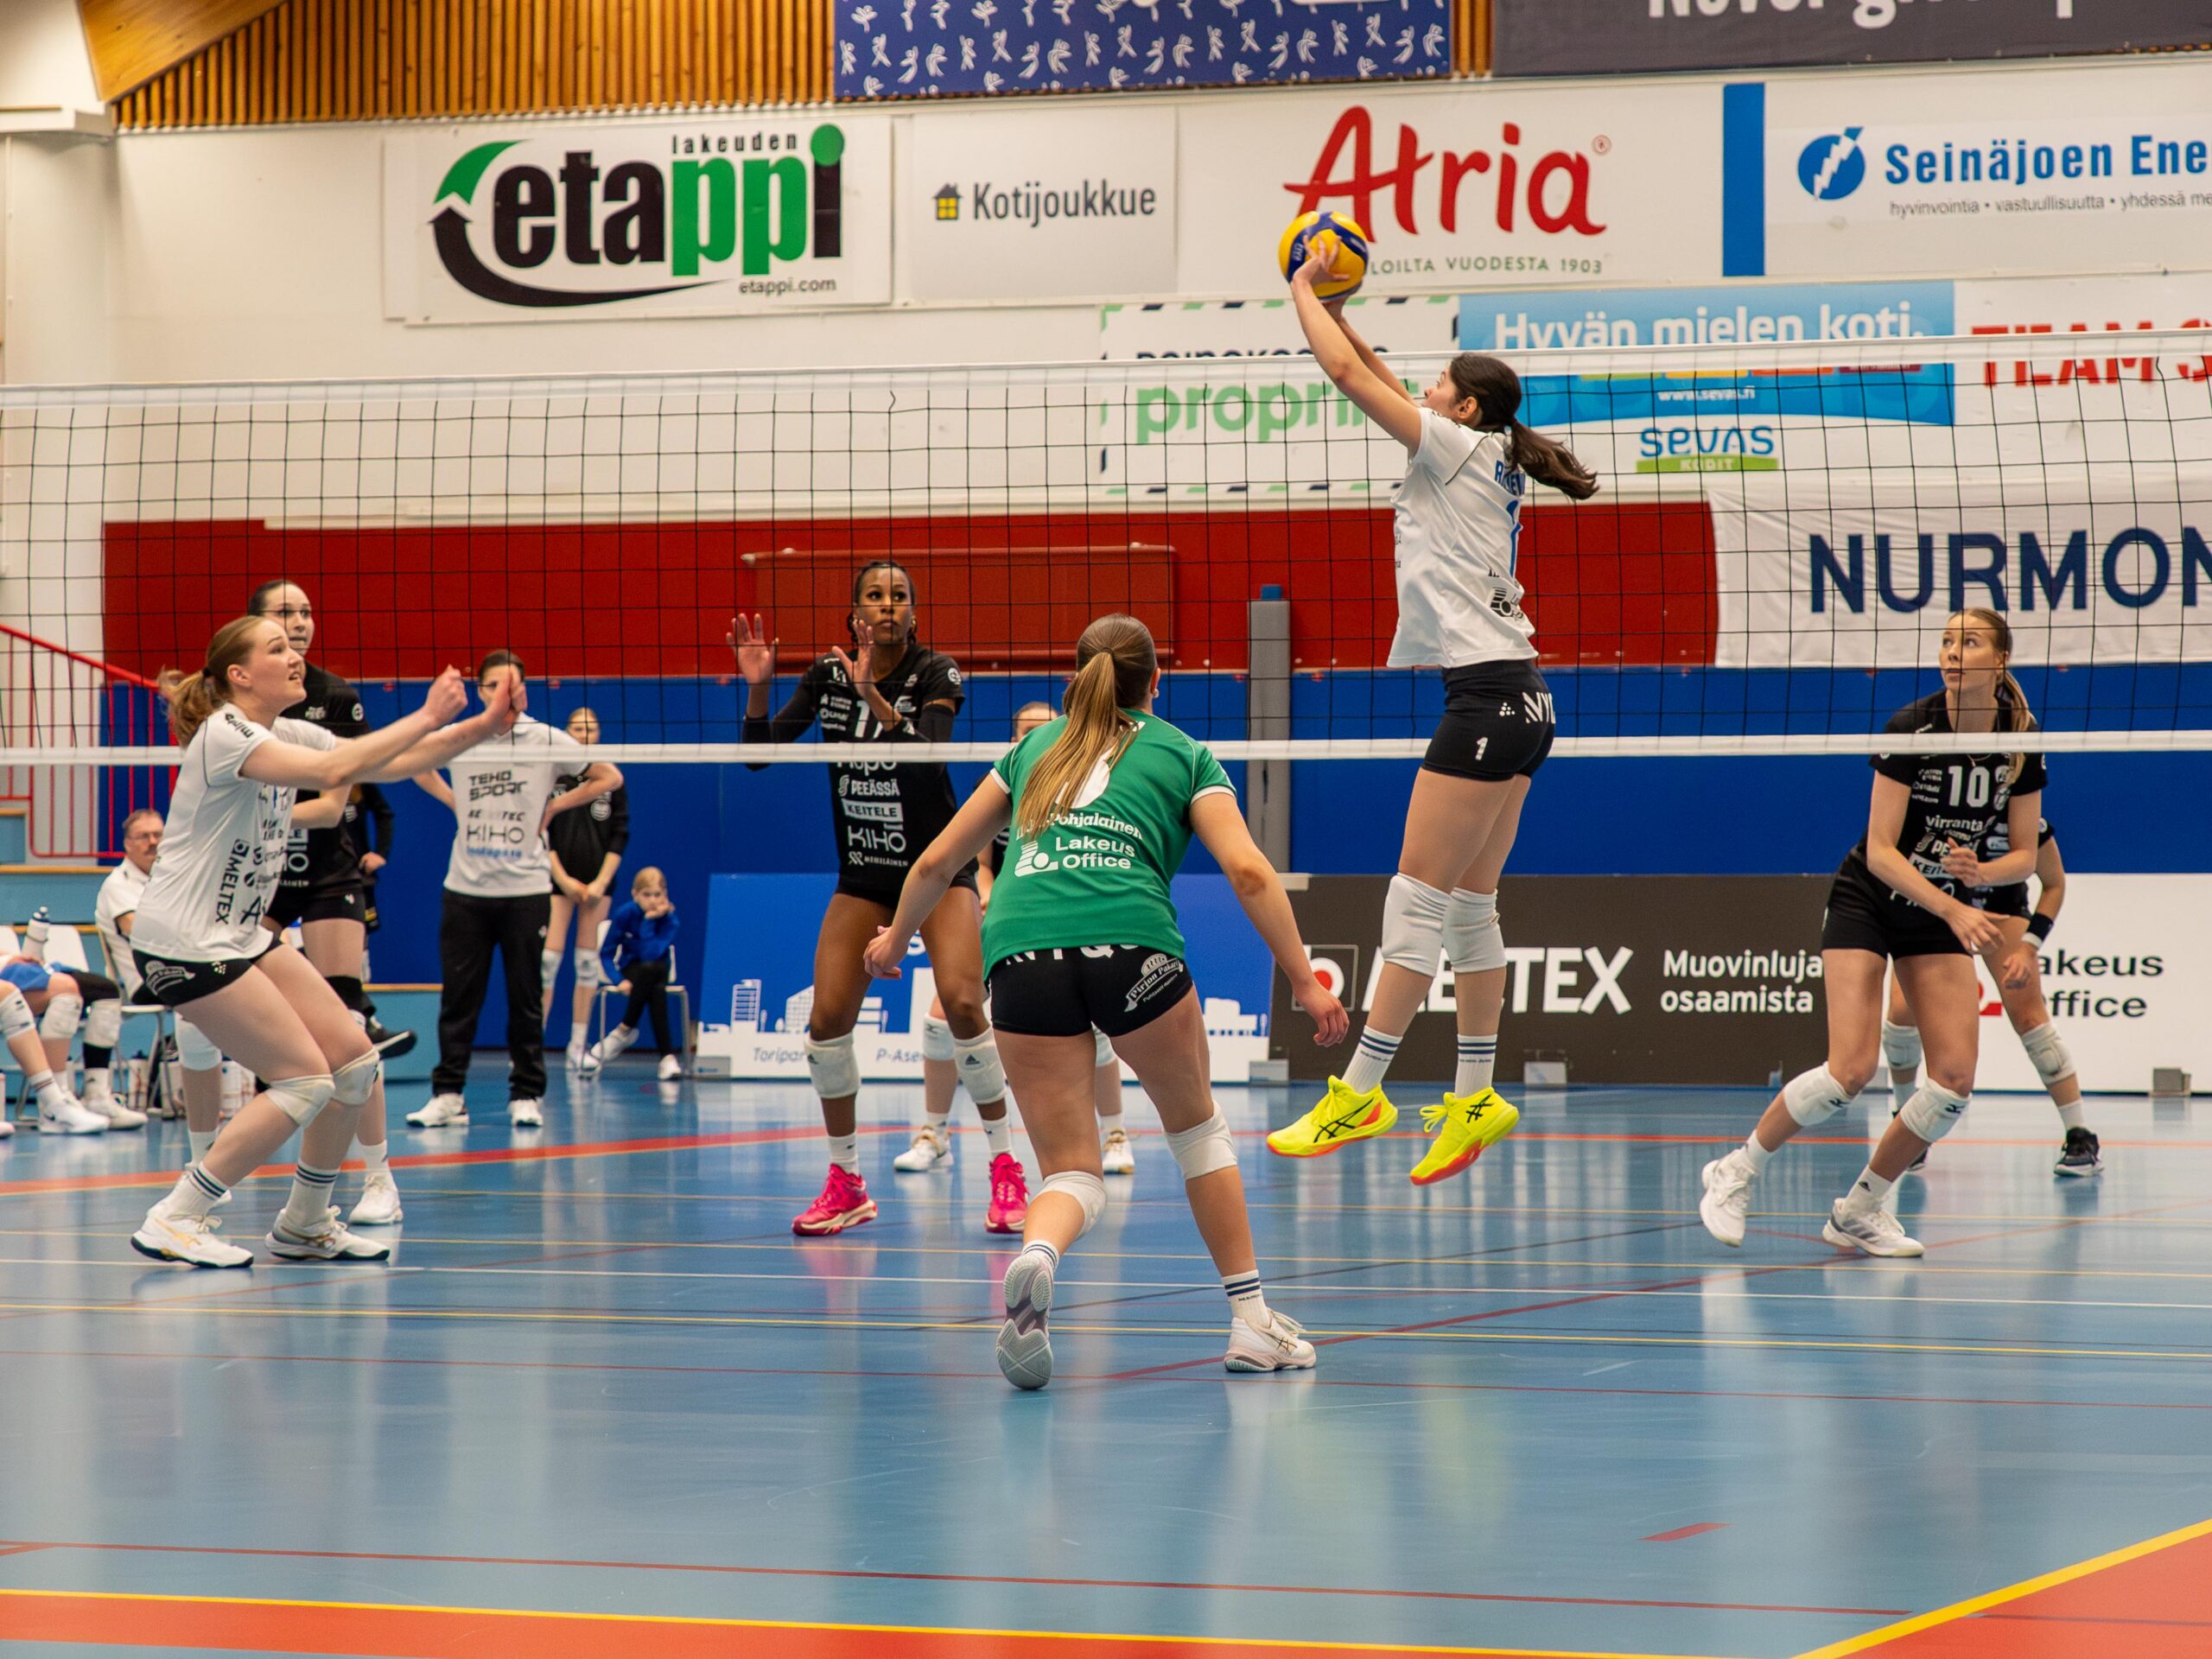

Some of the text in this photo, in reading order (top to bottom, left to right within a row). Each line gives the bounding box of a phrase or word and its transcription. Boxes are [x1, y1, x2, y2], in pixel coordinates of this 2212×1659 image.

[672, 132, 798, 155] lakeuden
[1283, 105, 1607, 243] Atria
[1885, 135, 2212, 186] Seinäjoen Ene
[493, 124, 845, 277] etappi
[974, 178, 1156, 228] Kotijoukkue
[1890, 191, 2212, 219] hyvinvointia vastuullisuutta yhdessä me
[1370, 257, 1603, 276] LOILTA VUODESTA 1903
[739, 276, 836, 295] etappi.com
[1496, 301, 1924, 349] Hyvän mielen koti.
[1475, 737, 1488, 761] 1
[851, 779, 900, 797] PEEÄSSÄ
[1948, 765, 1991, 808] 10
[847, 804, 898, 817] KEITELE
[1925, 815, 1984, 832] virranta
[467, 823, 524, 844] KIHO
[848, 825, 906, 853] KIHO
[1055, 836, 1136, 857] Lakeus
[1062, 853, 1132, 869] Office
[215, 857, 243, 925] MELTEX
[2037, 949, 2164, 977] akeus
[1362, 946, 1633, 1015] ETEX
[1661, 983, 1814, 1014] osaamista
[2043, 989, 2148, 1018] ffice
